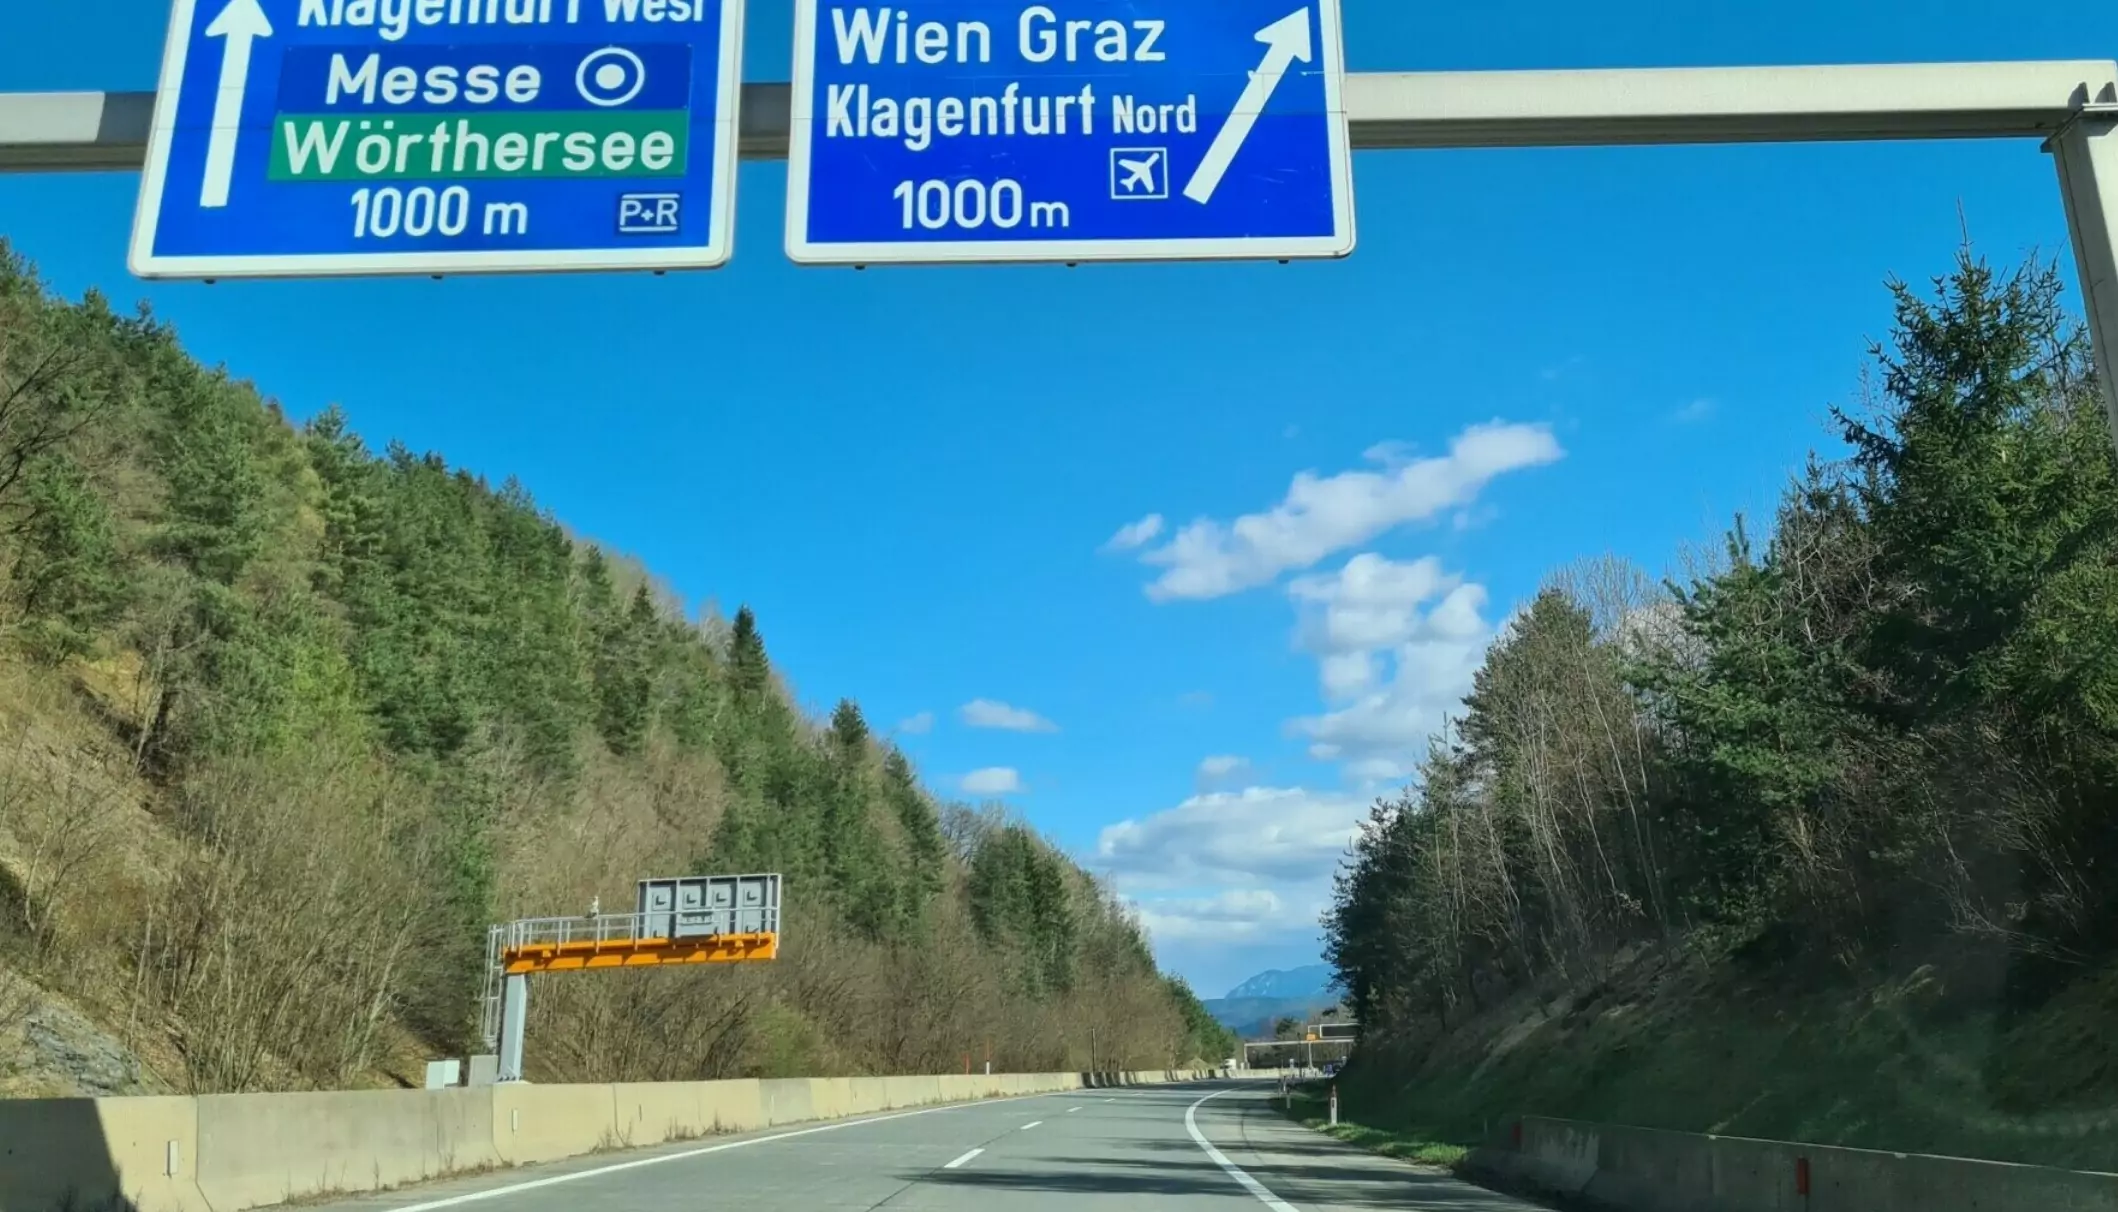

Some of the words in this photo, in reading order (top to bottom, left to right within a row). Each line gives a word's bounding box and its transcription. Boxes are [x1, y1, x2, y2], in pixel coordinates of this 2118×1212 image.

[832, 7, 990, 64] Wien
[1019, 5, 1166, 63] Graz
[326, 53, 541, 104] Messe
[826, 82, 1095, 152] Klagenfurt
[1112, 94, 1197, 134] Nord
[284, 119, 674, 174] Wörthersee
[351, 185, 469, 238] 1000
[483, 202, 528, 235] m
[619, 198, 679, 227] P+R
[894, 178, 1023, 229] 1000
[1030, 201, 1069, 227] m
